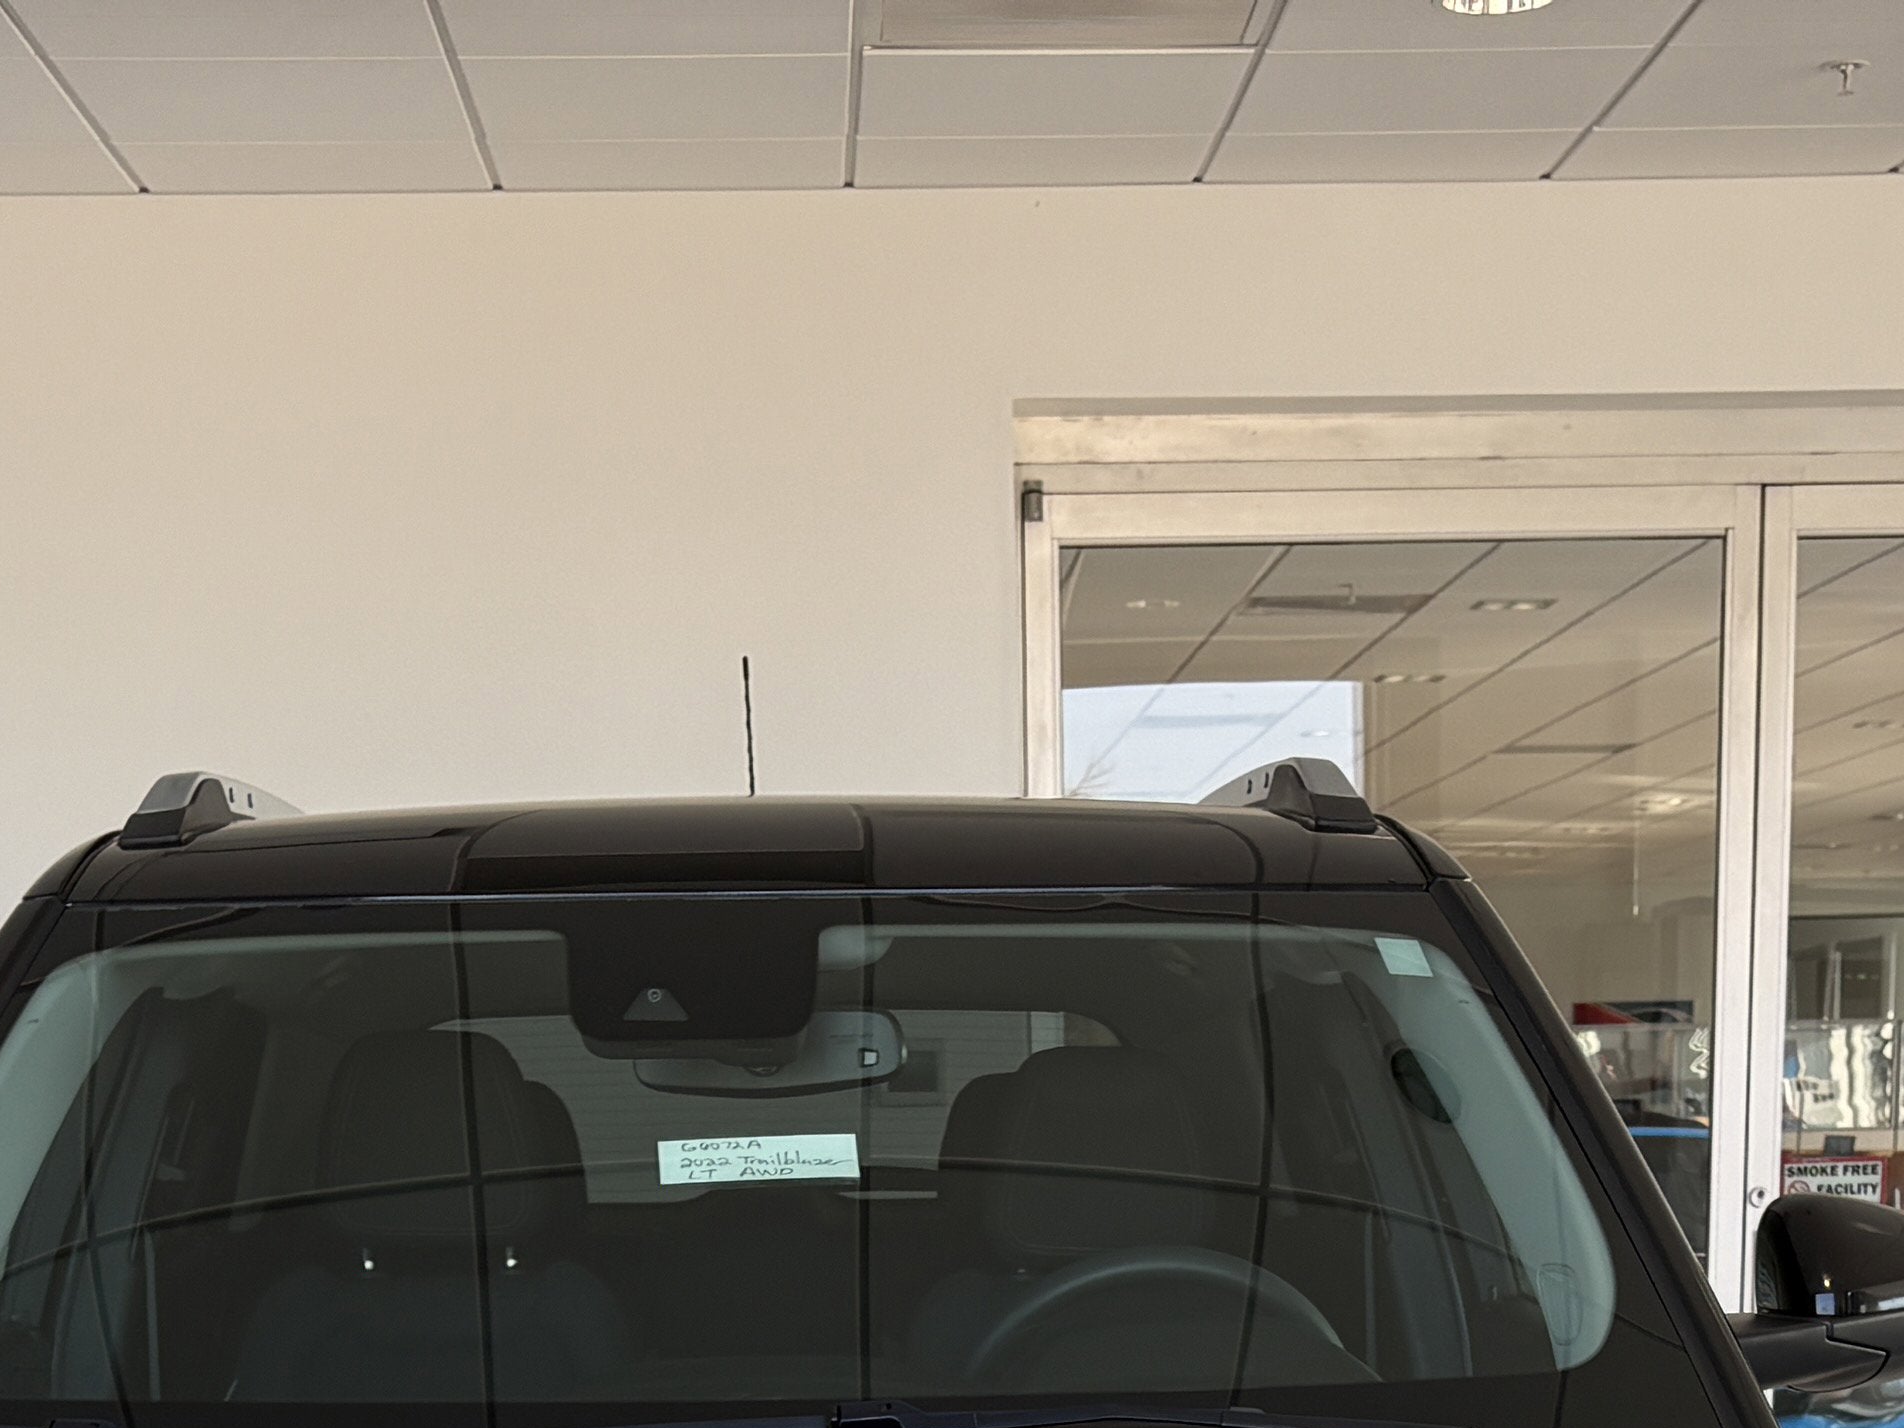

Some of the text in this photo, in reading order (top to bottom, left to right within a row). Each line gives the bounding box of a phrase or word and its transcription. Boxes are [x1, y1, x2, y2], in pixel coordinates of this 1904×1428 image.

[680, 1150, 854, 1169] 2022 Trailblazer
[688, 1167, 794, 1180] LT AWD
[1785, 1163, 1879, 1178] SMOKE FREE
[1817, 1181, 1879, 1195] FACILITY
